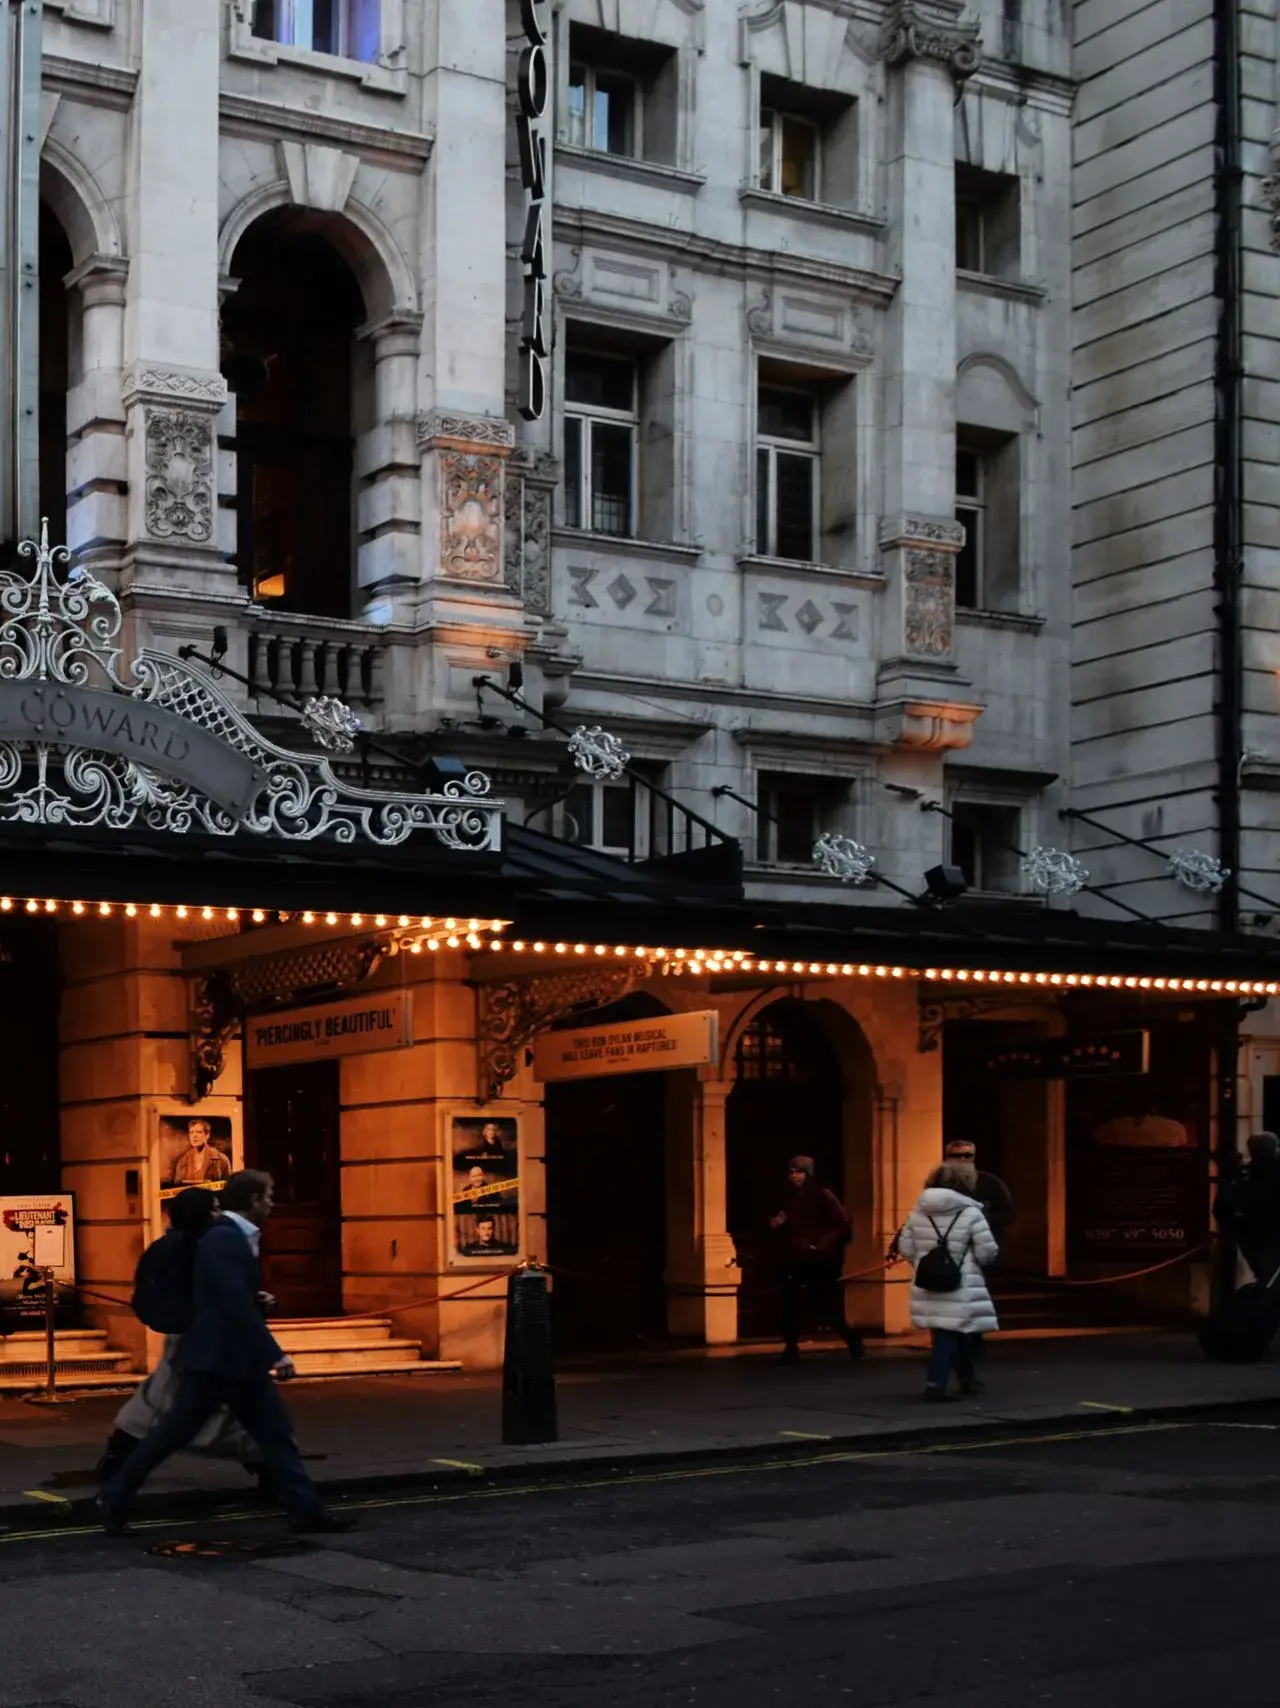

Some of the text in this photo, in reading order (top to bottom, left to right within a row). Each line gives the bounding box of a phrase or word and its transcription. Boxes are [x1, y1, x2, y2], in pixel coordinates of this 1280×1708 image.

[20, 697, 190, 761] COWARD
[14, 1210, 57, 1221] LIEUTENANT
[1151, 1227, 1186, 1241] 5050
